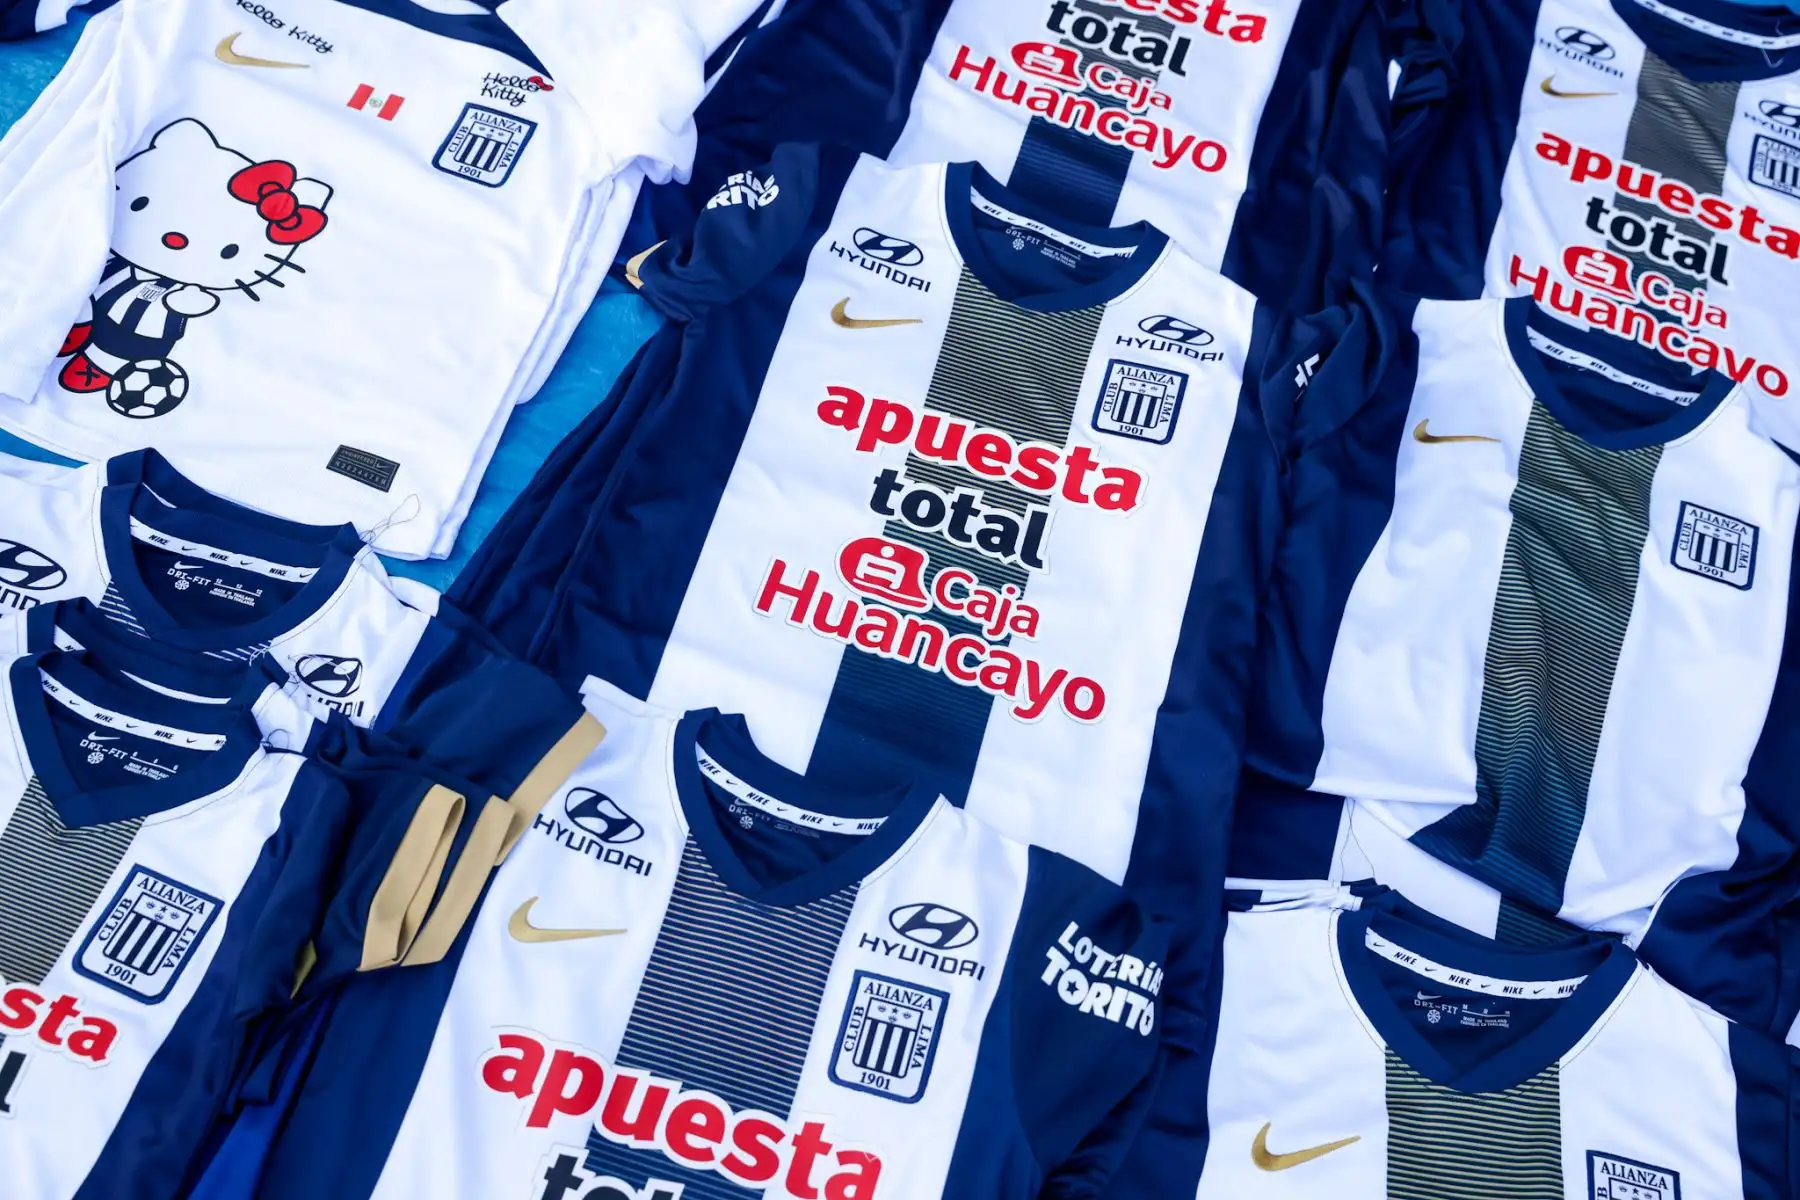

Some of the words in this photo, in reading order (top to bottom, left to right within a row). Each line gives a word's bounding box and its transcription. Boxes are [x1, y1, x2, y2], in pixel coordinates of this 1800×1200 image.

[236, 0, 285, 29] ello
[288, 25, 334, 54] Kitty
[1046, 1, 1193, 77] total
[1540, 37, 1624, 79] HYUNDAI
[480, 82, 526, 107] Kitty
[483, 72, 540, 92] Hello
[1089, 63, 1172, 111] Caja
[470, 112, 522, 133] ALIANZA
[949, 44, 1228, 173] Huancayo
[448, 125, 469, 153] CLUB
[499, 141, 520, 169] LIMA
[458, 165, 482, 179] 1901
[982, 205, 1001, 216] NIKE
[1535, 131, 1800, 260] apuesta
[1005, 228, 1041, 246] DRI-FIT
[1585, 196, 1729, 285] total
[829, 240, 931, 292] HYUNDAI
[1641, 274, 1728, 329] Caja
[1116, 335, 1224, 362] HYUNDAI
[1545, 344, 1564, 356] NIKE
[1117, 366, 1175, 385] ALIANZA
[1102, 382, 1118, 412] CLUB
[1160, 394, 1176, 423] LIMA
[817, 385, 1142, 512] apuesta
[1118, 424, 1144, 436] 1901
[869, 467, 1049, 570] total
[1679, 522, 1692, 551] CLUB
[1689, 509, 1748, 535] ALIANZA
[149, 534, 170, 546] NIKE
[209, 552, 229, 562] NIKE
[269, 567, 288, 577] NIKE
[1698, 564, 1724, 578] 1901
[1738, 542, 1750, 569] LIMA
[167, 568, 211, 587] DRI-FIT
[935, 570, 1040, 638] Caja
[756, 559, 1106, 720] Huancayo
[42, 680, 58, 693] NIKE
[94, 712, 113, 723] NIKE
[154, 730, 174, 740] NIKE
[80, 739, 128, 760] DRI-FIT
[699, 758, 720, 775] NIKE
[746, 792, 770, 806] NIKE
[799, 814, 824, 825] NIKE
[532, 813, 652, 877] HYUNDAI
[137, 877, 206, 915] ALIANZA
[98, 898, 133, 941] CLUB
[161, 926, 197, 969] LIMA
[858, 932, 985, 981] HYUNDAI
[104, 963, 138, 985] 1901
[1041, 946, 1155, 1036] TORITO
[1393, 951, 1417, 965] NIKE
[1448, 973, 1472, 986] NIKE
[1502, 985, 1524, 995] NIKE
[1557, 984, 1576, 994] NIK
[864, 982, 933, 1011] ALIANZA
[1414, 999, 1459, 1015] DRI-FIT
[844, 1005, 865, 1052] CLUB
[910, 1024, 932, 1069] LIMA
[859, 1071, 891, 1090] 1901
[482, 1034, 881, 1200] apuesta
[1600, 1161, 1669, 1190] ALIANZA
